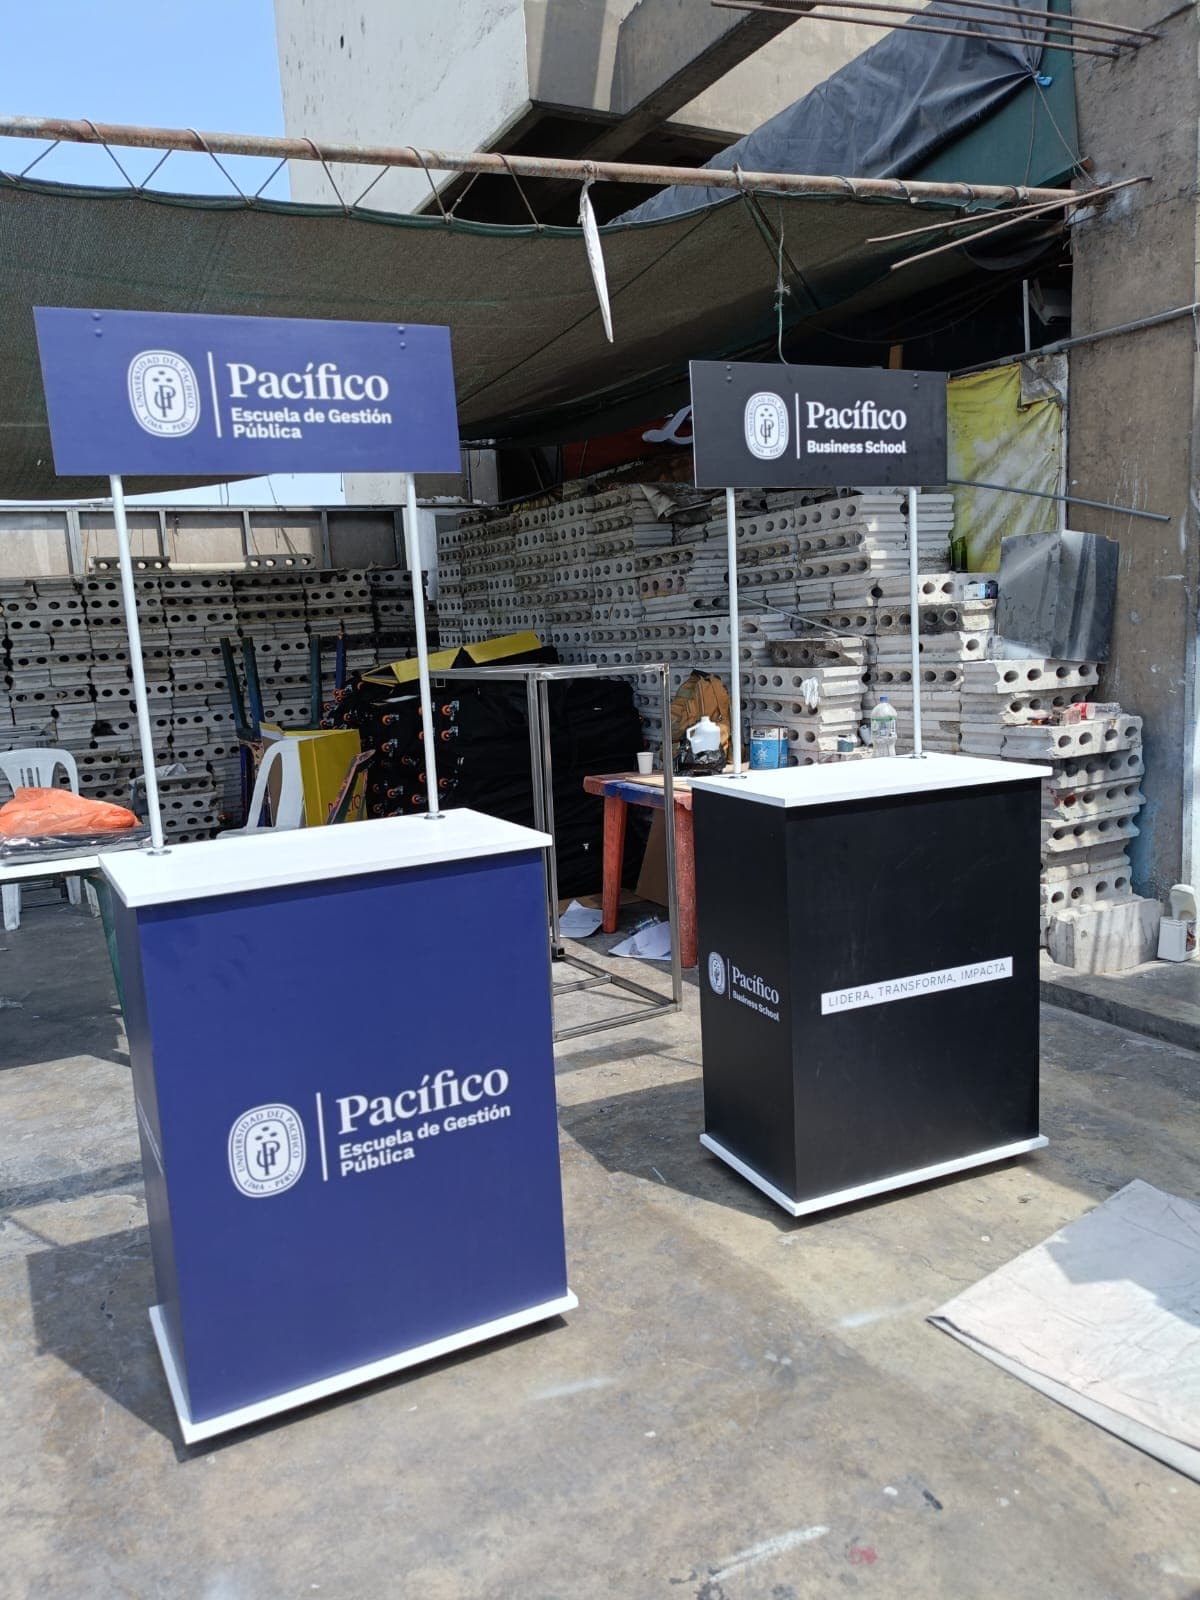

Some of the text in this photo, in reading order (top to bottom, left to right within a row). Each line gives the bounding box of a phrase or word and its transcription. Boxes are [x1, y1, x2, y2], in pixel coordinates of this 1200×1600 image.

[226, 362, 390, 402] Pacífico
[231, 406, 392, 424] Escuela de Gestión
[232, 422, 303, 440] Pública
[805, 400, 907, 430] Pacífico
[806, 439, 907, 454] Business School
[731, 965, 780, 1004] Pacífico
[828, 962, 1006, 1007] LIDERA, TRANSFORMA, IMPACTA
[732, 990, 780, 1022] Business School
[335, 1068, 509, 1135] Pacífico
[235, 1114, 264, 1173] UNIVERSIDAD
[267, 1110, 284, 1119] DEL
[339, 1103, 511, 1160] Escuela de Gestión
[340, 1146, 415, 1177] Pública
[243, 1179, 265, 1190] LIMA
